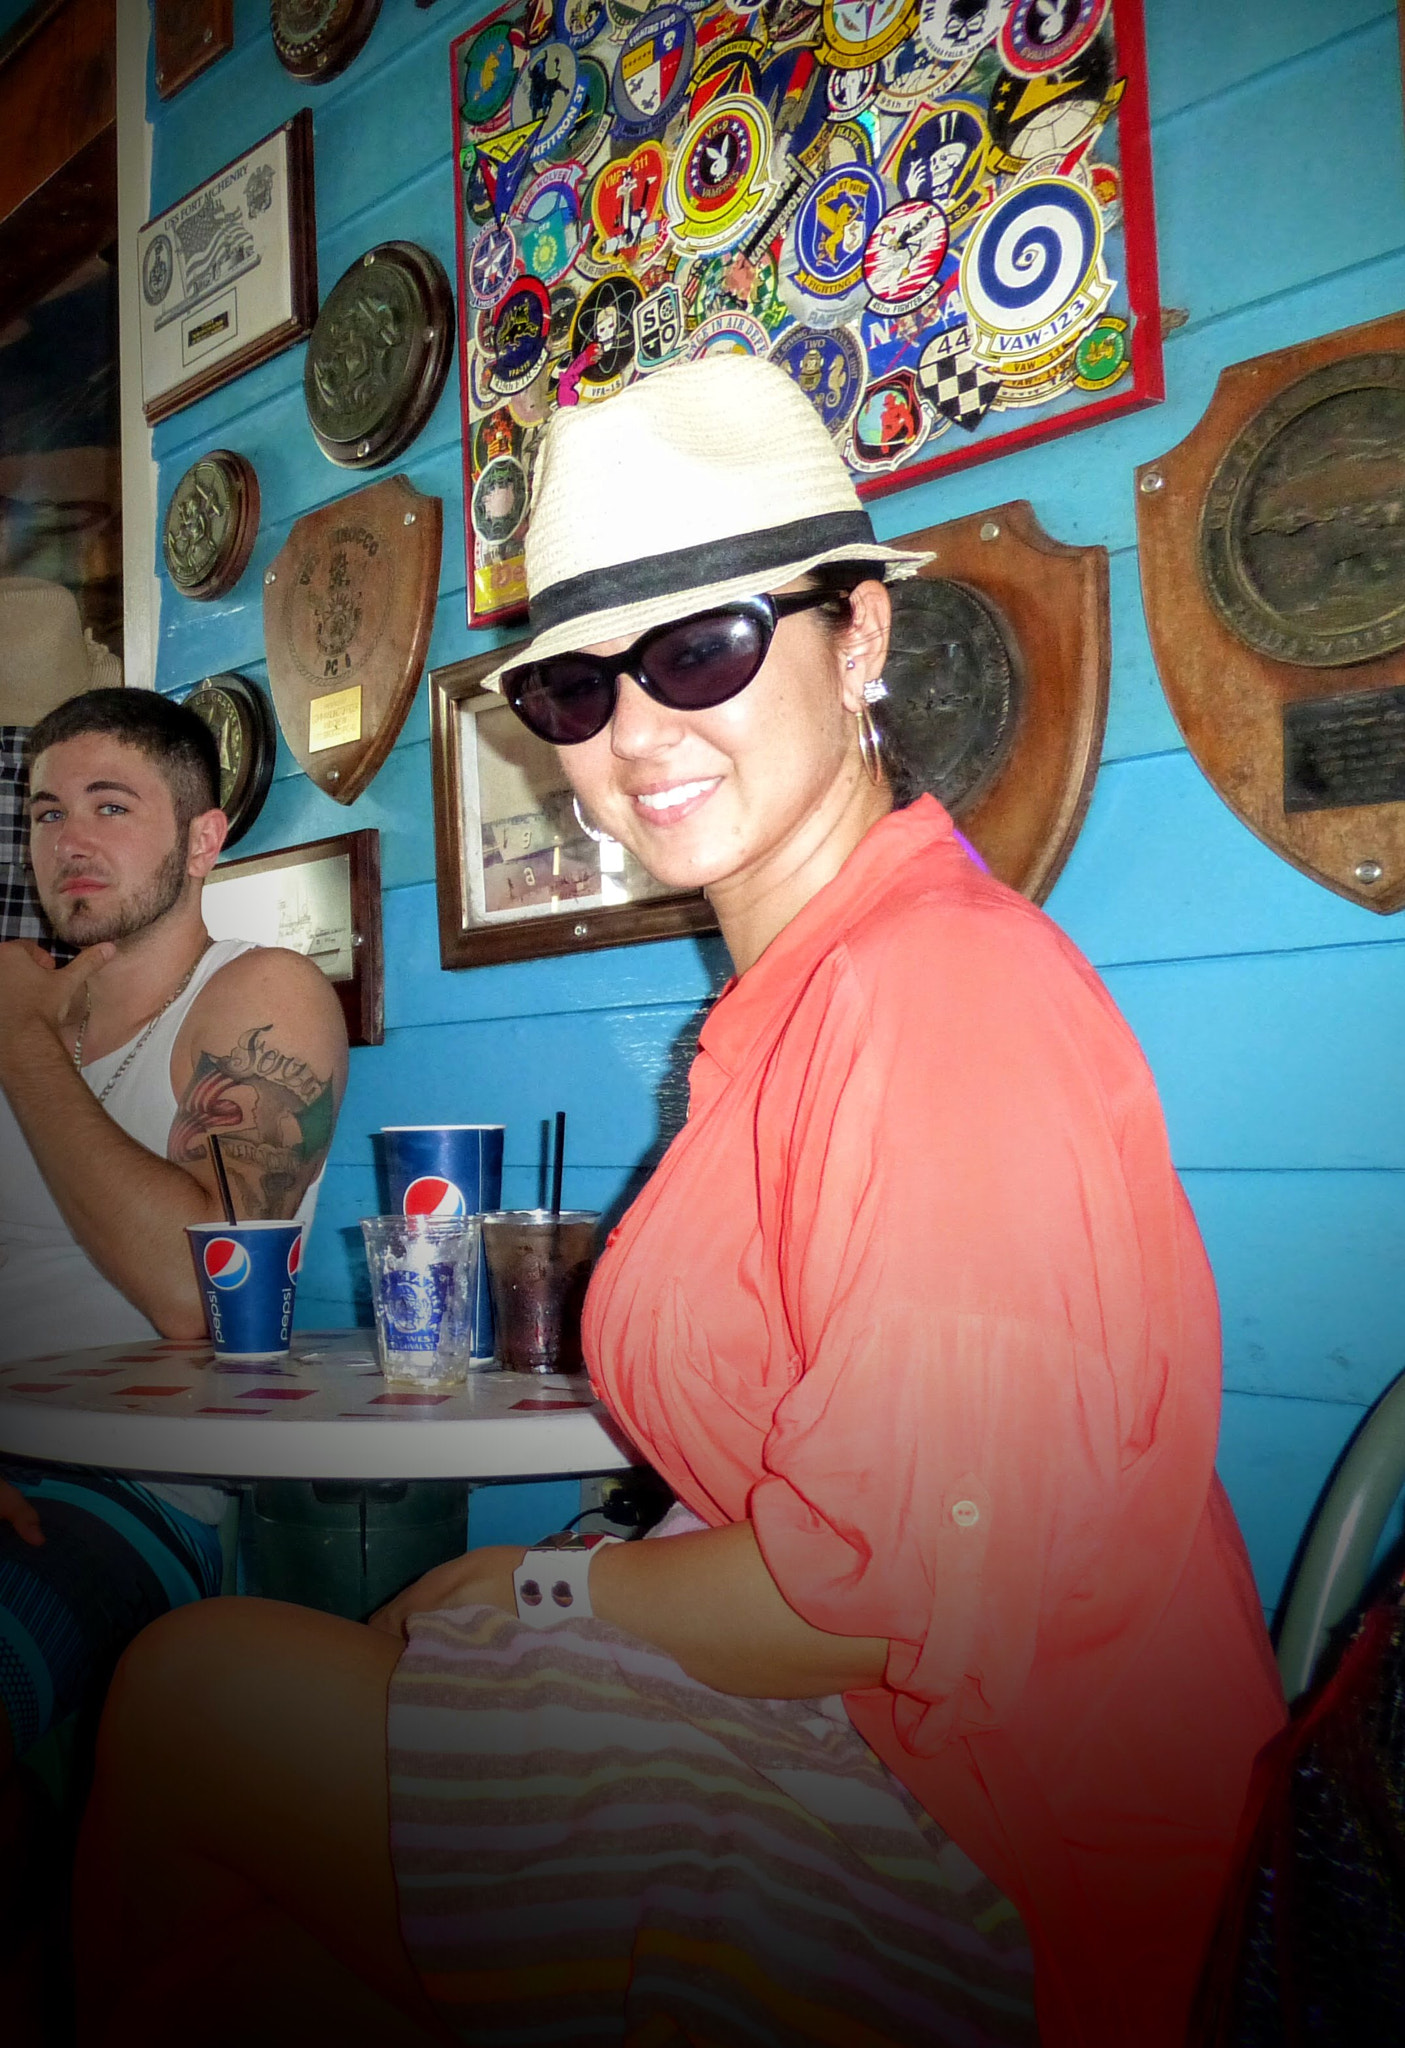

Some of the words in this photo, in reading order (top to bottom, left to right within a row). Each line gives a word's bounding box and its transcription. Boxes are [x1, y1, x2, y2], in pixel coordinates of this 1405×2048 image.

[629, 23, 659, 47] FIGHTING
[660, 13, 676, 30] TWO
[906, 72, 958, 107] FIHTER
[705, 119, 729, 140] VX-9
[836, 125, 862, 148] HAWK
[634, 155, 649, 172] 311
[748, 182, 811, 264] KATRINEHOLM
[955, 203, 970, 219] SQ
[809, 277, 851, 294] FIGHTING
[892, 296, 923, 313] FIGHTER
[925, 285, 935, 298] SQ
[712, 321, 723, 333] IN
[726, 317, 744, 329] AIR
[999, 300, 1085, 351] VAW-123
[804, 339, 826, 350] TWO
[937, 328, 971, 354] 44
[324, 658, 338, 676] PC
[206, 1290, 225, 1343] pepsi
[280, 1288, 292, 1341] pepsi
